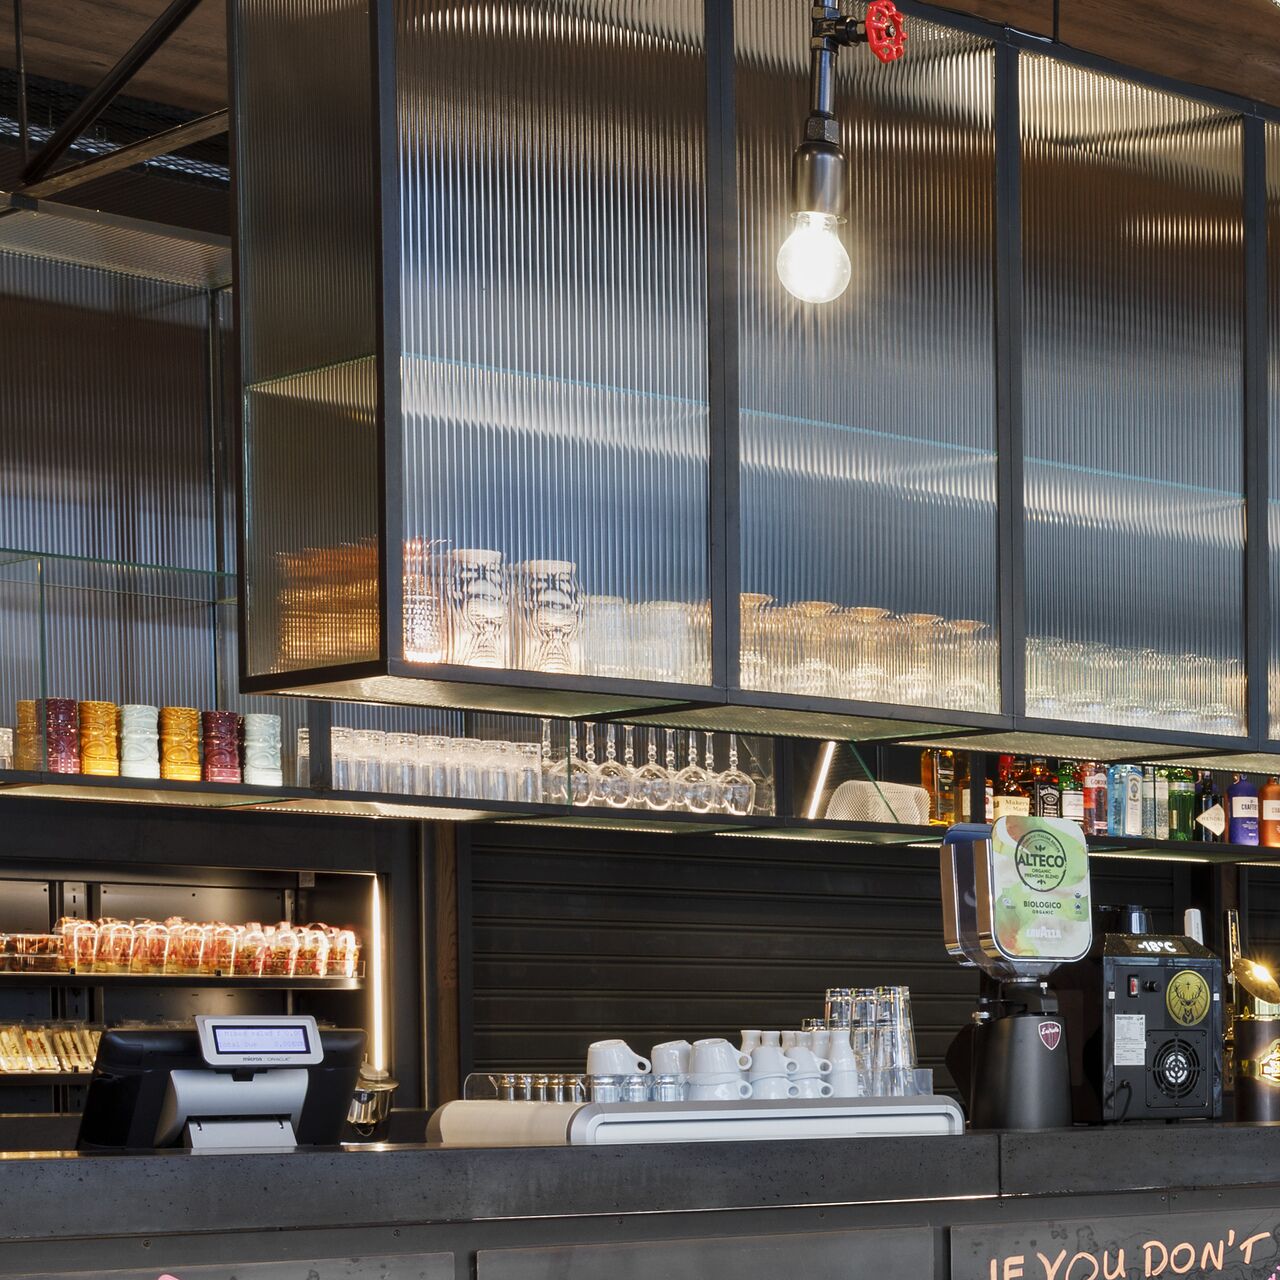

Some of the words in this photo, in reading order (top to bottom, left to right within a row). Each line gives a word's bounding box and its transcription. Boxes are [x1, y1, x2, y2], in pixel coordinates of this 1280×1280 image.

[1018, 853, 1064, 868] ALTECO
[1023, 900, 1062, 909] BIOLOGICO
[1143, 1229, 1271, 1278] DON'T
